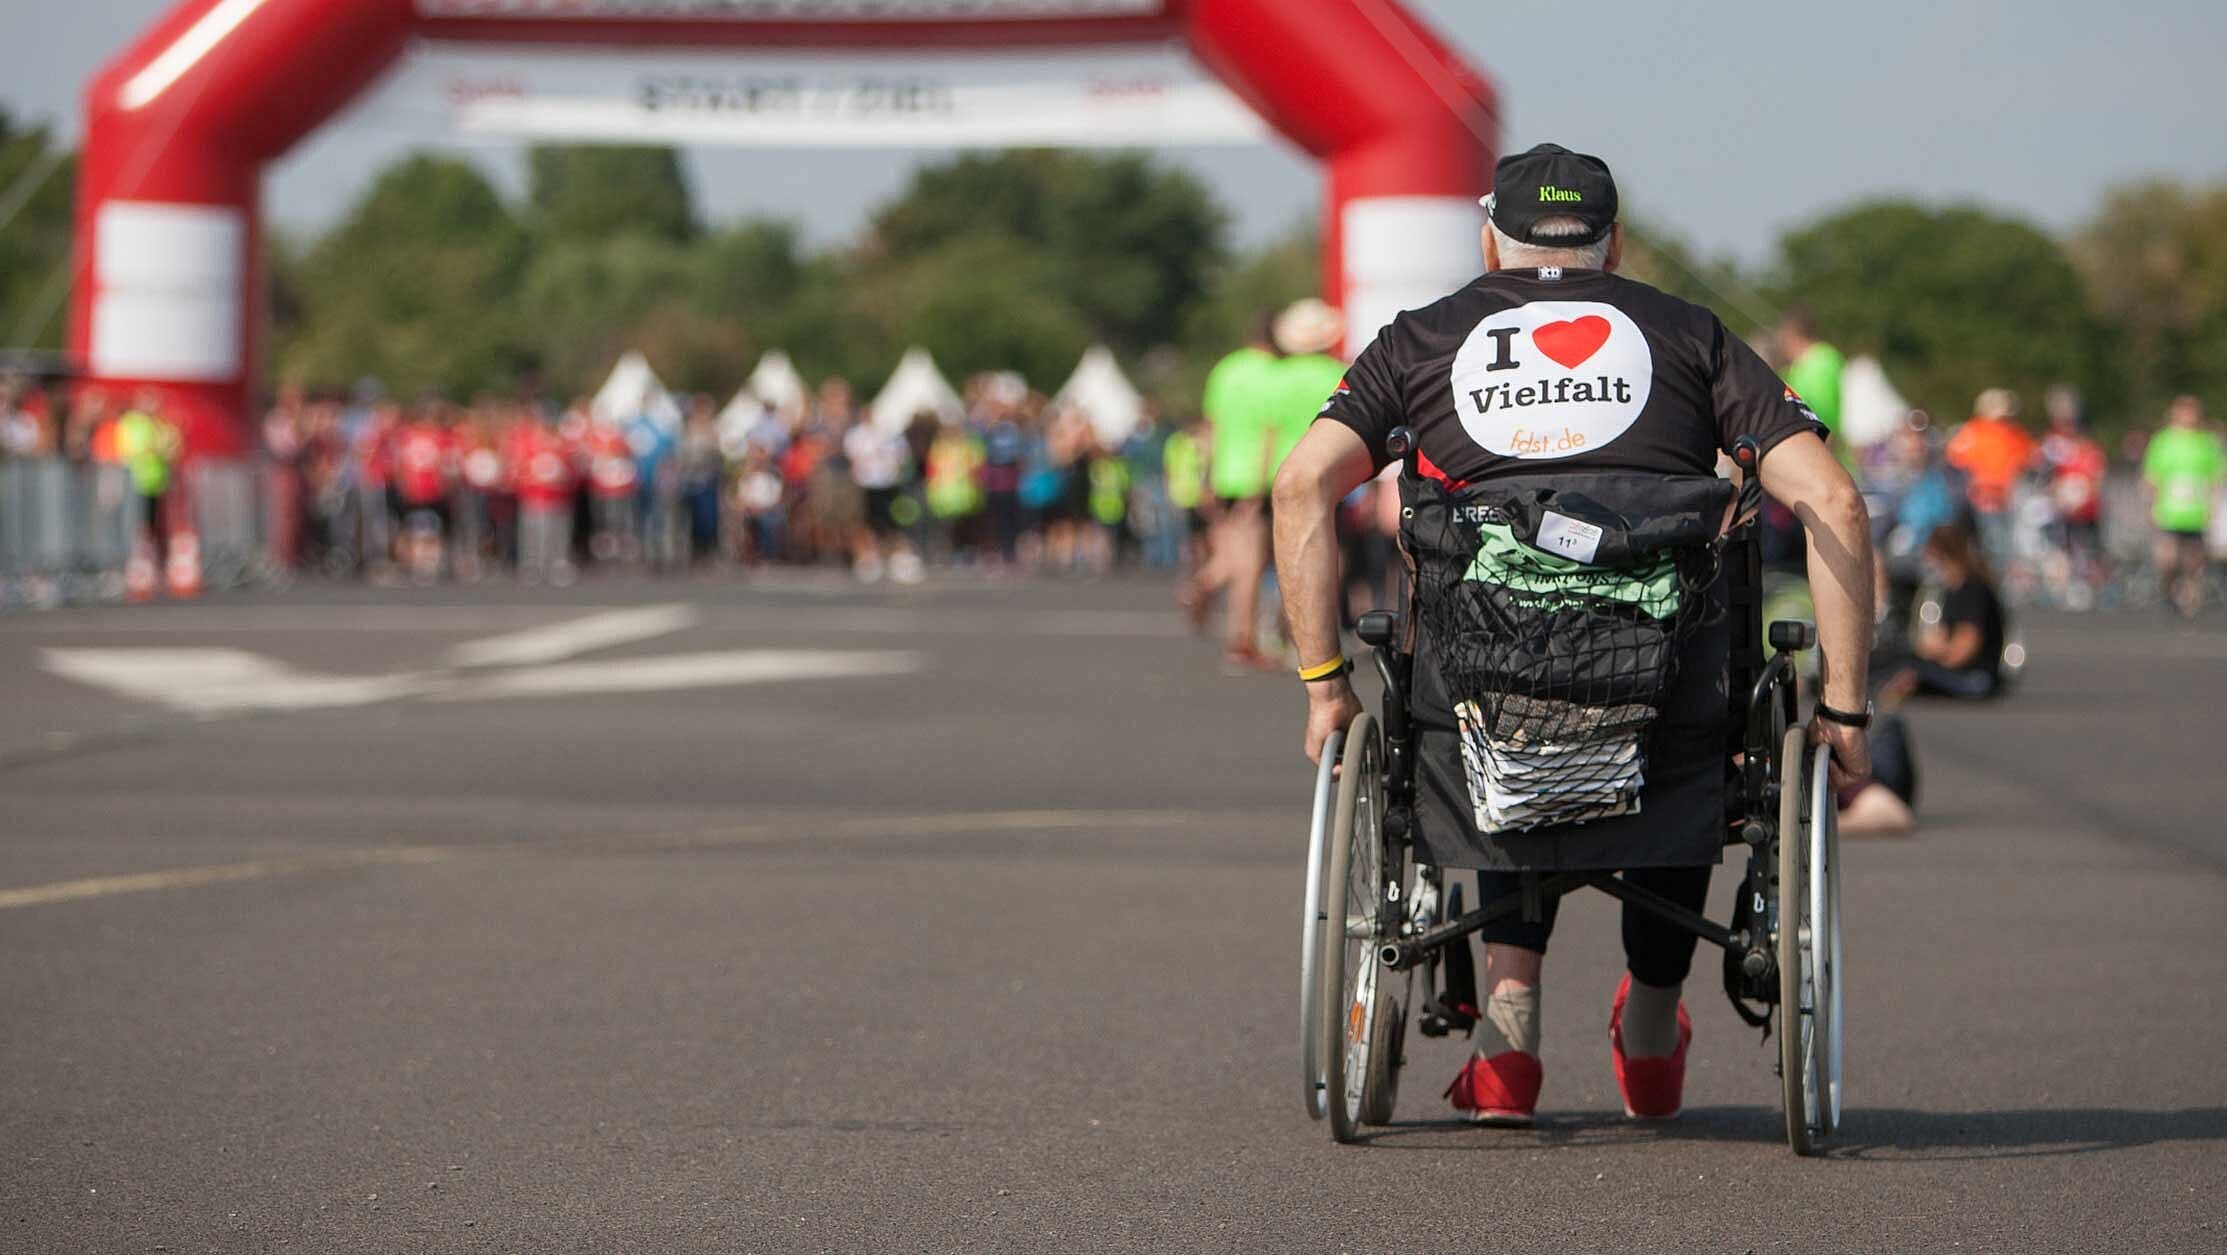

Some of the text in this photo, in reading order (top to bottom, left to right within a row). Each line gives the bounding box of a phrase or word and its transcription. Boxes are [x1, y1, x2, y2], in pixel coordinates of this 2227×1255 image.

[1539, 185, 1582, 202] Klaus
[1486, 327, 1521, 371] I
[1469, 376, 1632, 414] Vielfalt
[1510, 427, 1586, 454] fdst.de
